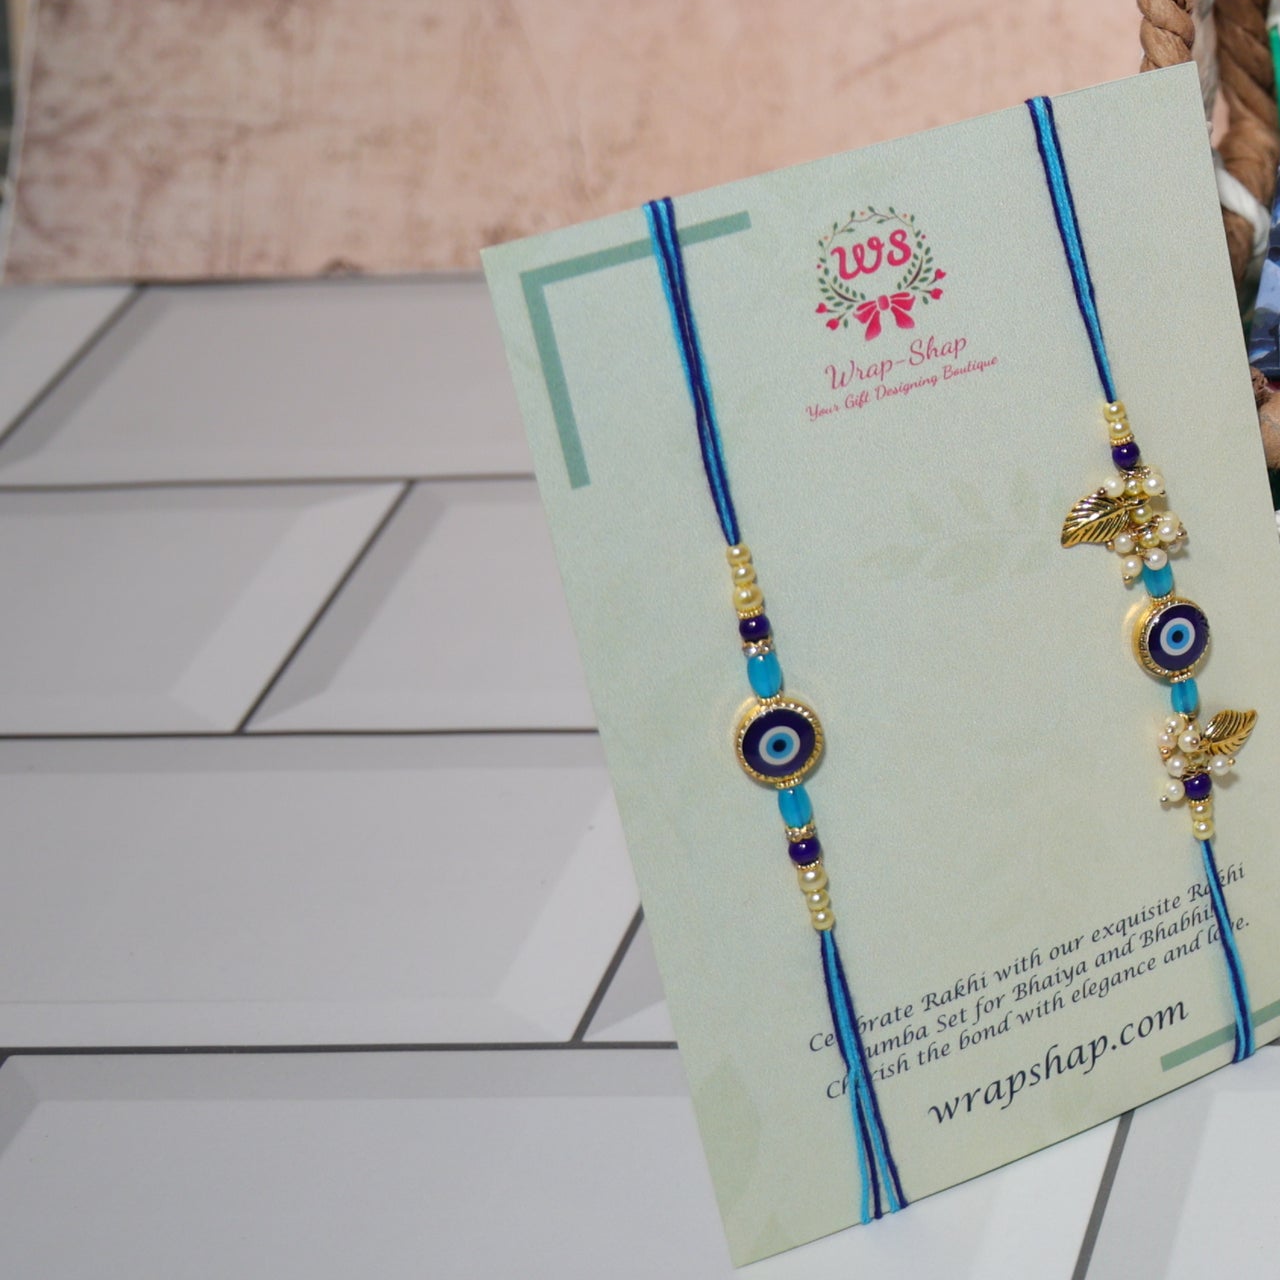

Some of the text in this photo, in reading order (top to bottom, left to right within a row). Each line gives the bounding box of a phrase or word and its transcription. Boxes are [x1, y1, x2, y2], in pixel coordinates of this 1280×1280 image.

[830, 229, 912, 280] WS
[805, 356, 998, 421] Your Gift Designing Boutique
[825, 336, 968, 390] Wrap-Shap
[809, 1004, 915, 1052] Cebrate
[921, 972, 988, 1012] Rakhi
[993, 948, 1043, 982] with
[1050, 935, 1084, 960] our
[1091, 896, 1182, 943] exquisite
[862, 1024, 929, 1058] umba
[936, 1007, 968, 1032] Set
[972, 994, 1006, 1026] for
[1012, 960, 1088, 1002] Bhaiya
[1095, 933, 1136, 968] and
[917, 1041, 951, 1066] the
[959, 1011, 1013, 1048] bond
[1016, 990, 1065, 1025] with
[1071, 957, 1157, 1003] elegance
[1163, 930, 1204, 964] and
[928, 1000, 1188, 1125] wrapshap.com
